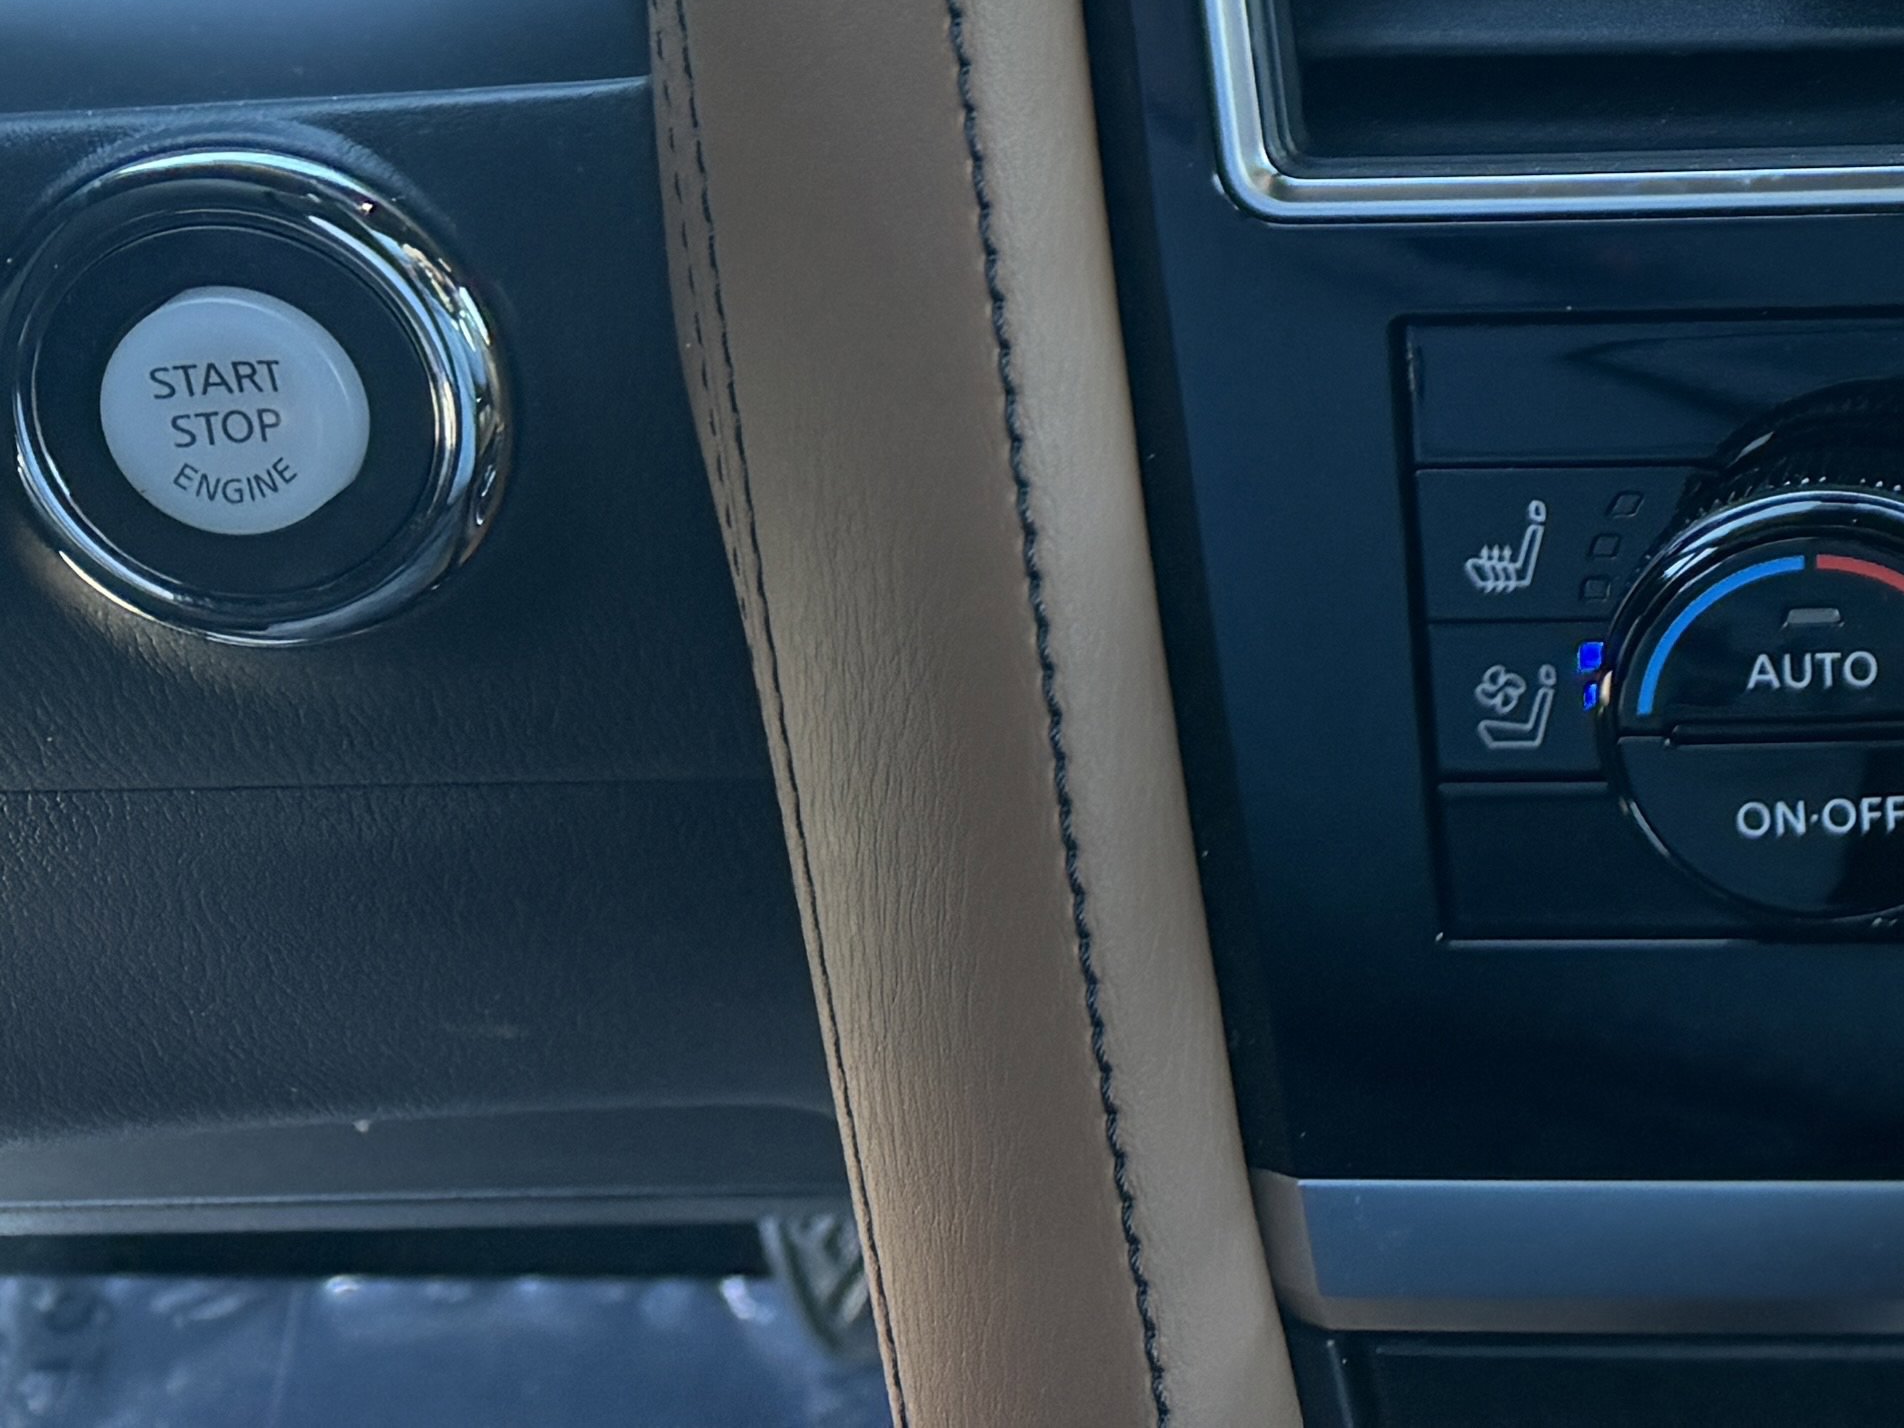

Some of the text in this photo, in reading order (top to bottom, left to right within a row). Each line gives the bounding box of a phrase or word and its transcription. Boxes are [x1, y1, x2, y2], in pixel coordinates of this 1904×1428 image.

[148, 358, 282, 402] START
[169, 407, 283, 449] STOP
[172, 456, 300, 505] ENGINE
[1745, 649, 1879, 692] AUTO
